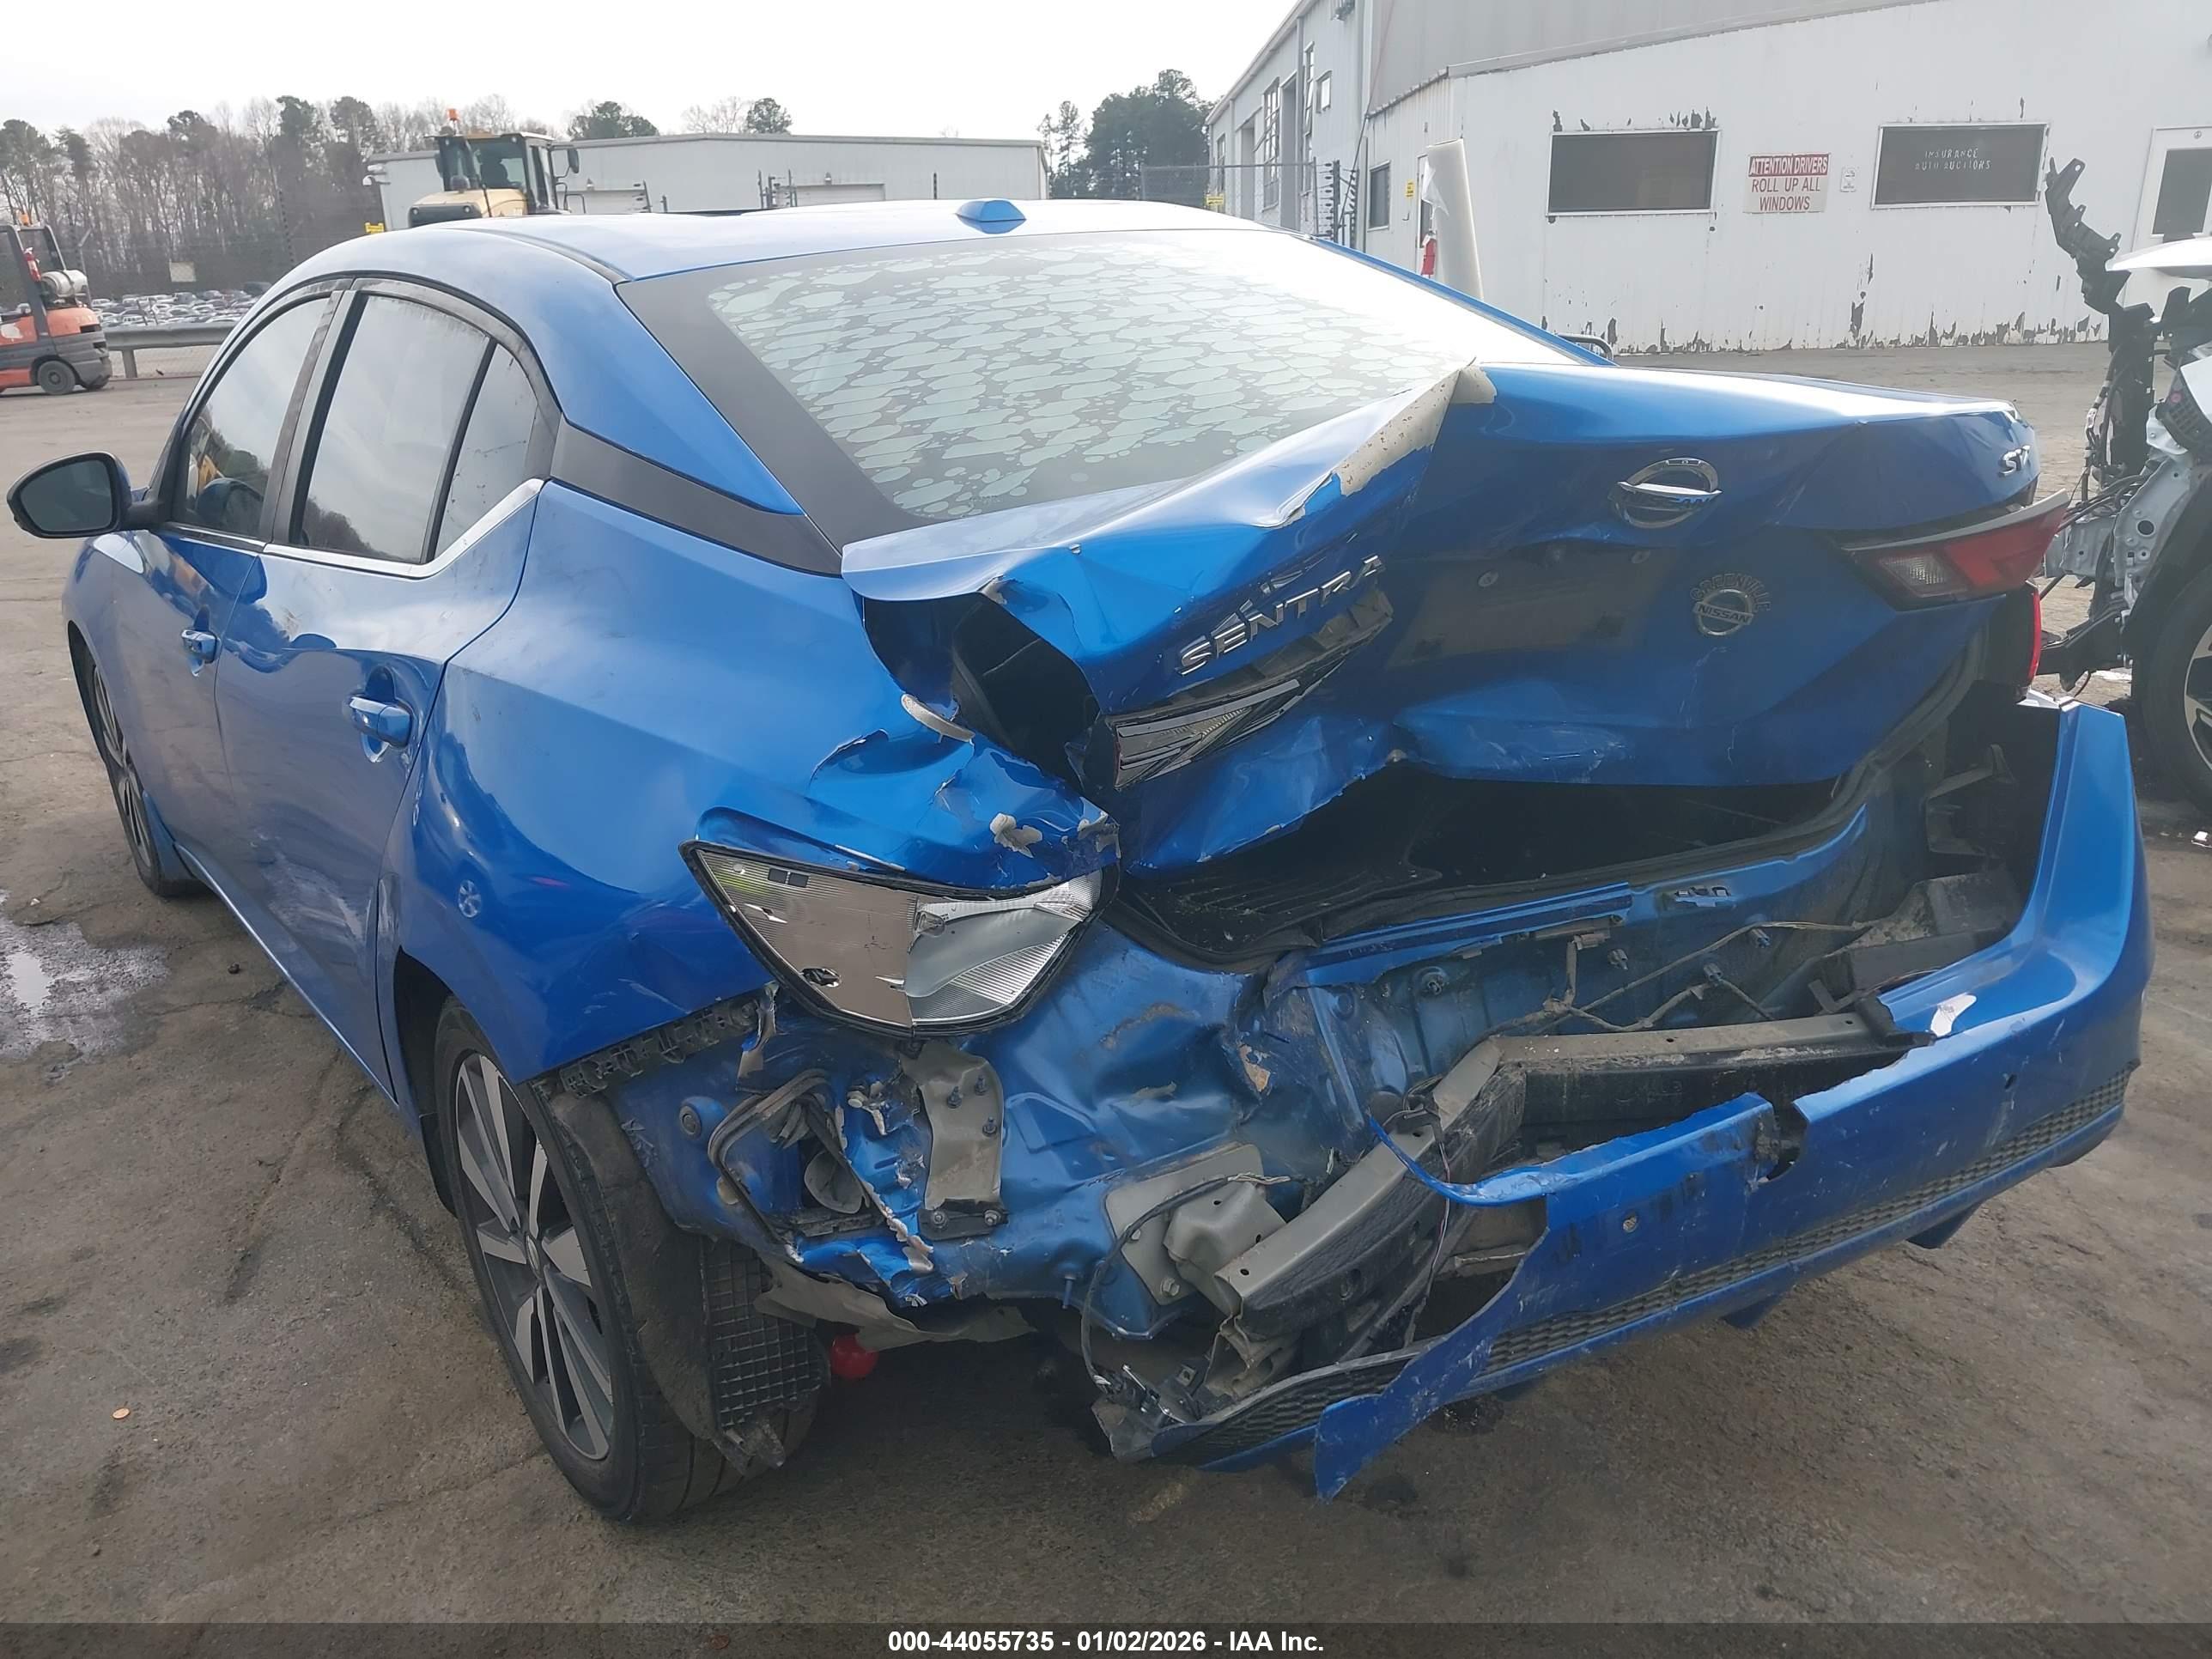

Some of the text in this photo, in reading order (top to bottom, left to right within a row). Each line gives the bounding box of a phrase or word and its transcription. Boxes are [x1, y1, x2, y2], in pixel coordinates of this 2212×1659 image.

[1749, 156, 1828, 175] ATTENTION DRIVERS
[1752, 176, 1821, 193] ROLL UP ALL
[1759, 196, 1811, 211] WINDOWS
[1175, 554, 1385, 677] SENTRA
[1697, 603, 1752, 624] NISSAN
